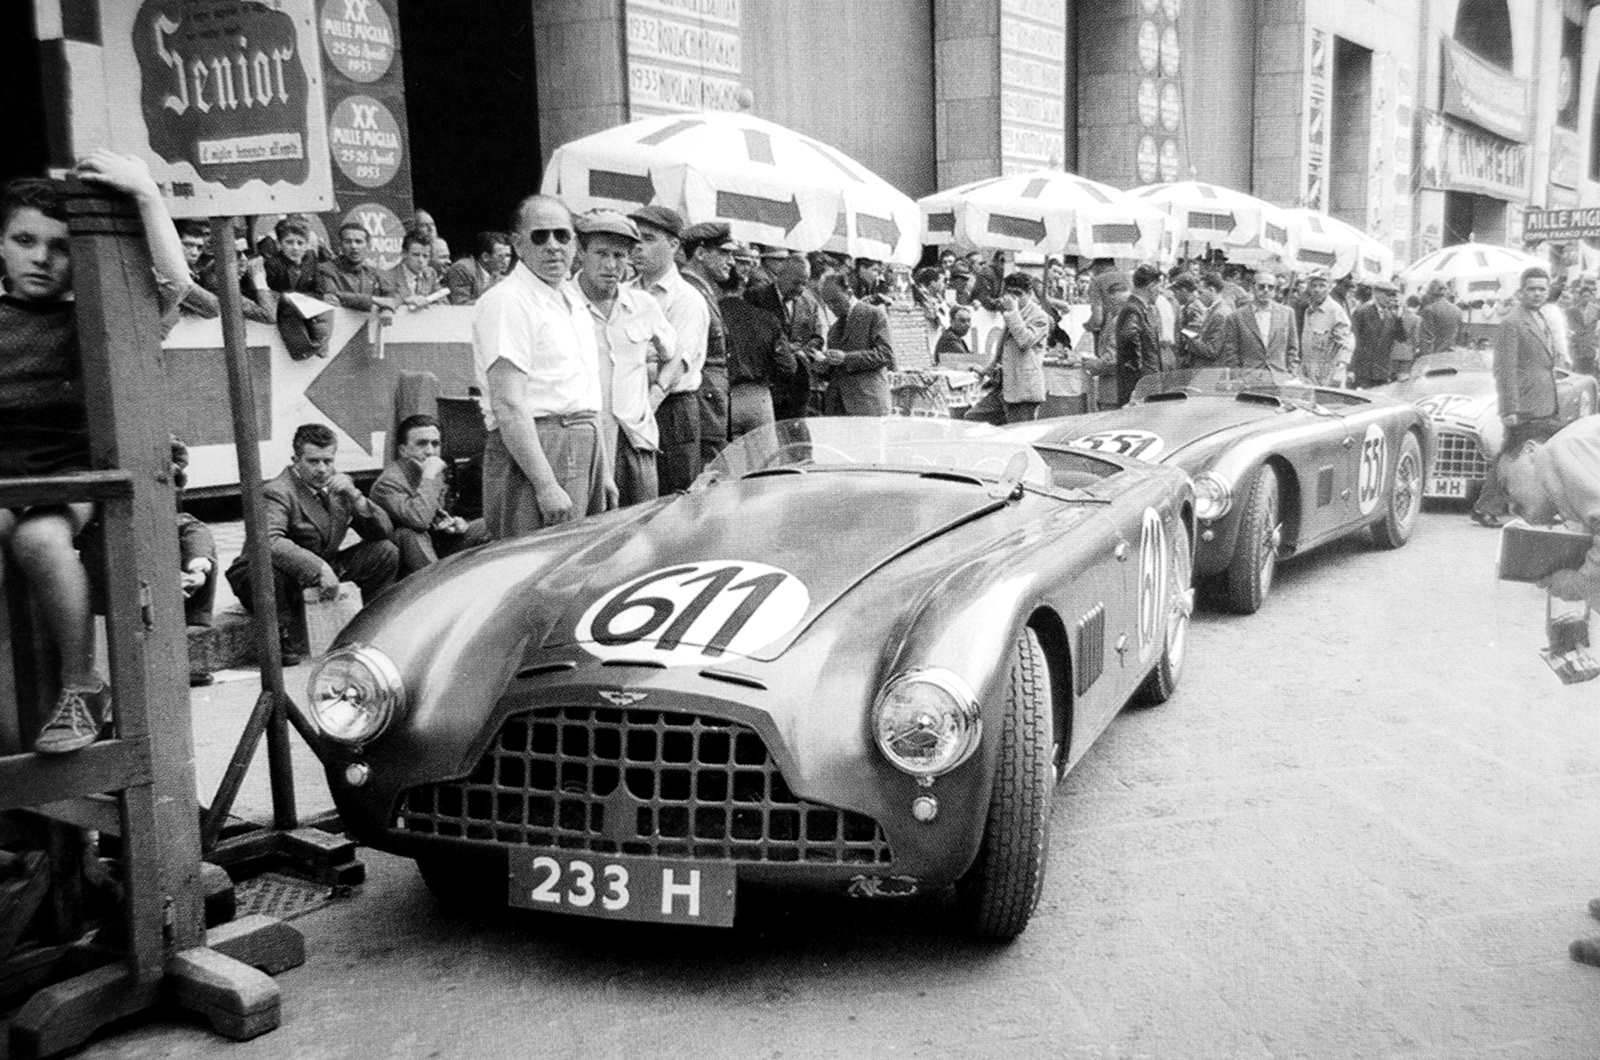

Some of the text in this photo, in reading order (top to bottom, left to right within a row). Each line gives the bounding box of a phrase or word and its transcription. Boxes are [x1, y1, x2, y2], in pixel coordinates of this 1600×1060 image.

[344, 0, 369, 23] XX
[324, 19, 391, 45] MILLE MIGLIA
[629, 17, 655, 42] 1932
[154, 13, 294, 116] Senior
[631, 68, 658, 91] 1933
[351, 103, 379, 130] XX
[332, 127, 399, 149] MILLE MIGLIA
[1361, 436, 1384, 503] 551
[590, 566, 788, 657] 611
[531, 856, 701, 917] 233 H
